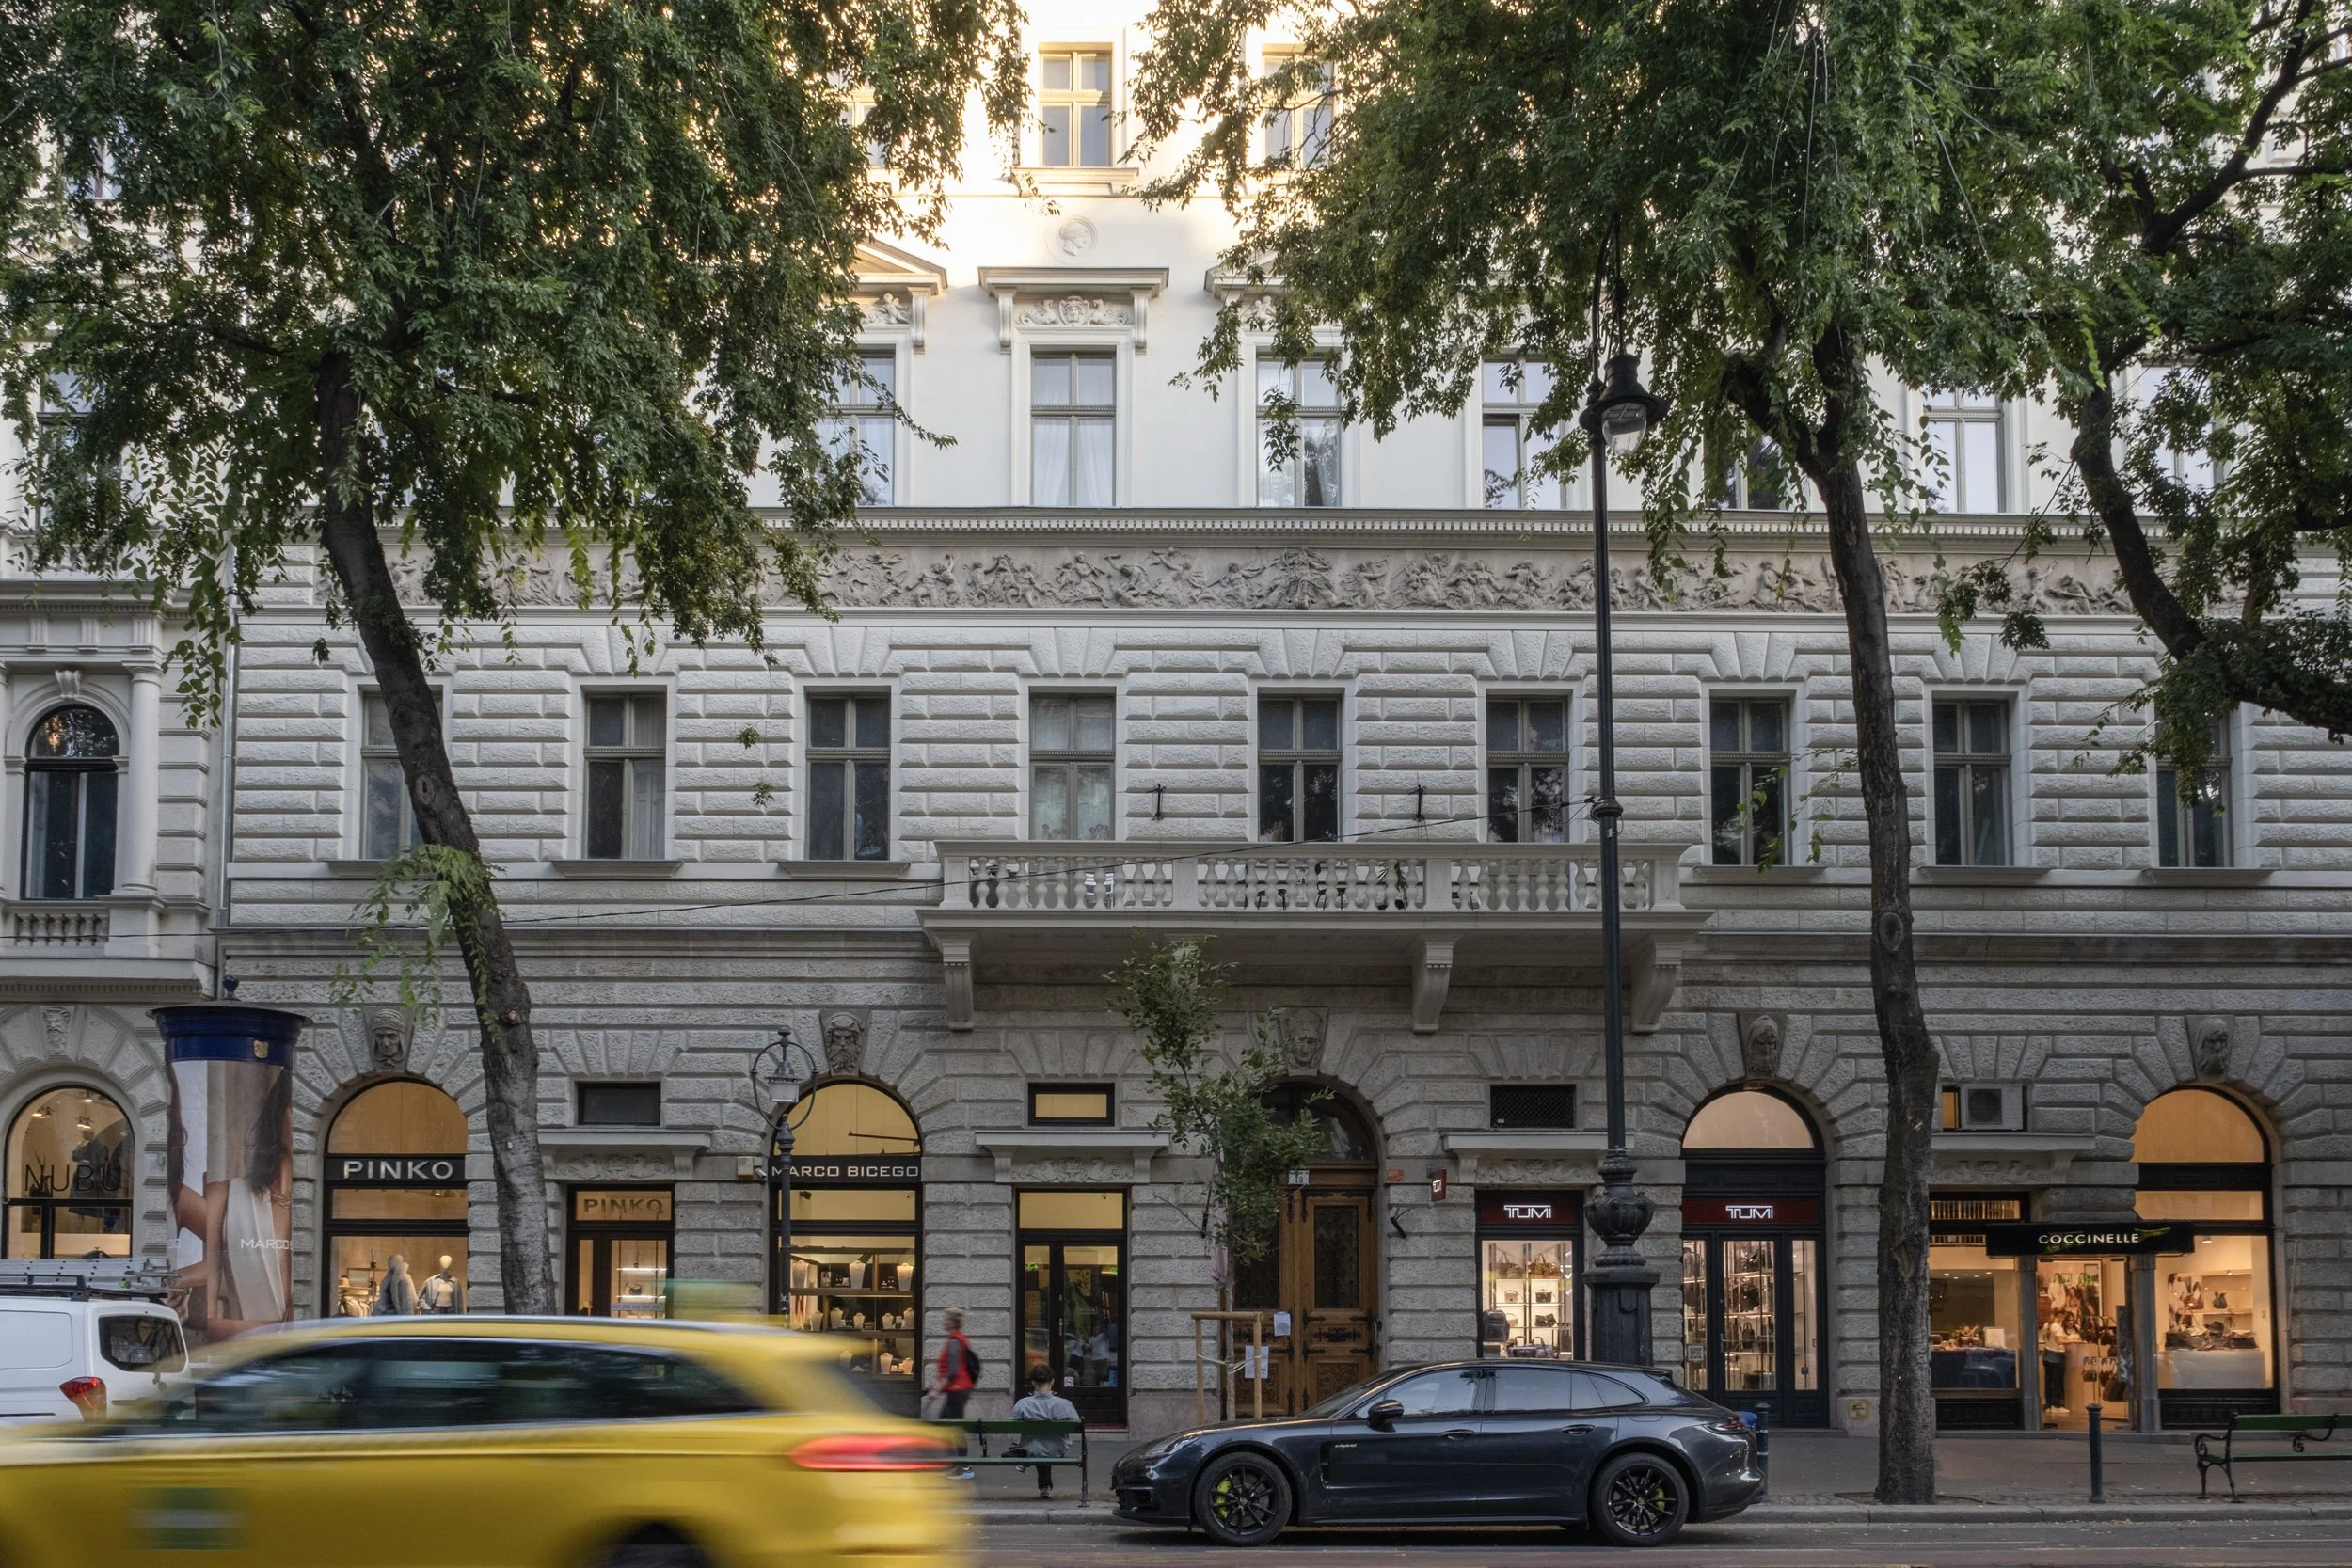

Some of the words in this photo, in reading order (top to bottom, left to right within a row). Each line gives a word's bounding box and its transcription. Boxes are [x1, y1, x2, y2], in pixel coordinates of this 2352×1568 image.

[343, 1160, 453, 1180] PINKO
[771, 1165, 840, 1177] MARCO
[848, 1165, 919, 1177] BICEGO
[583, 1198, 663, 1212] PINKO
[1503, 1205, 1551, 1219] TUMI
[1725, 1205, 1773, 1219] TUMI
[240, 1238, 290, 1250] MARCO
[2038, 1233, 2139, 1244] COCCINELLE
